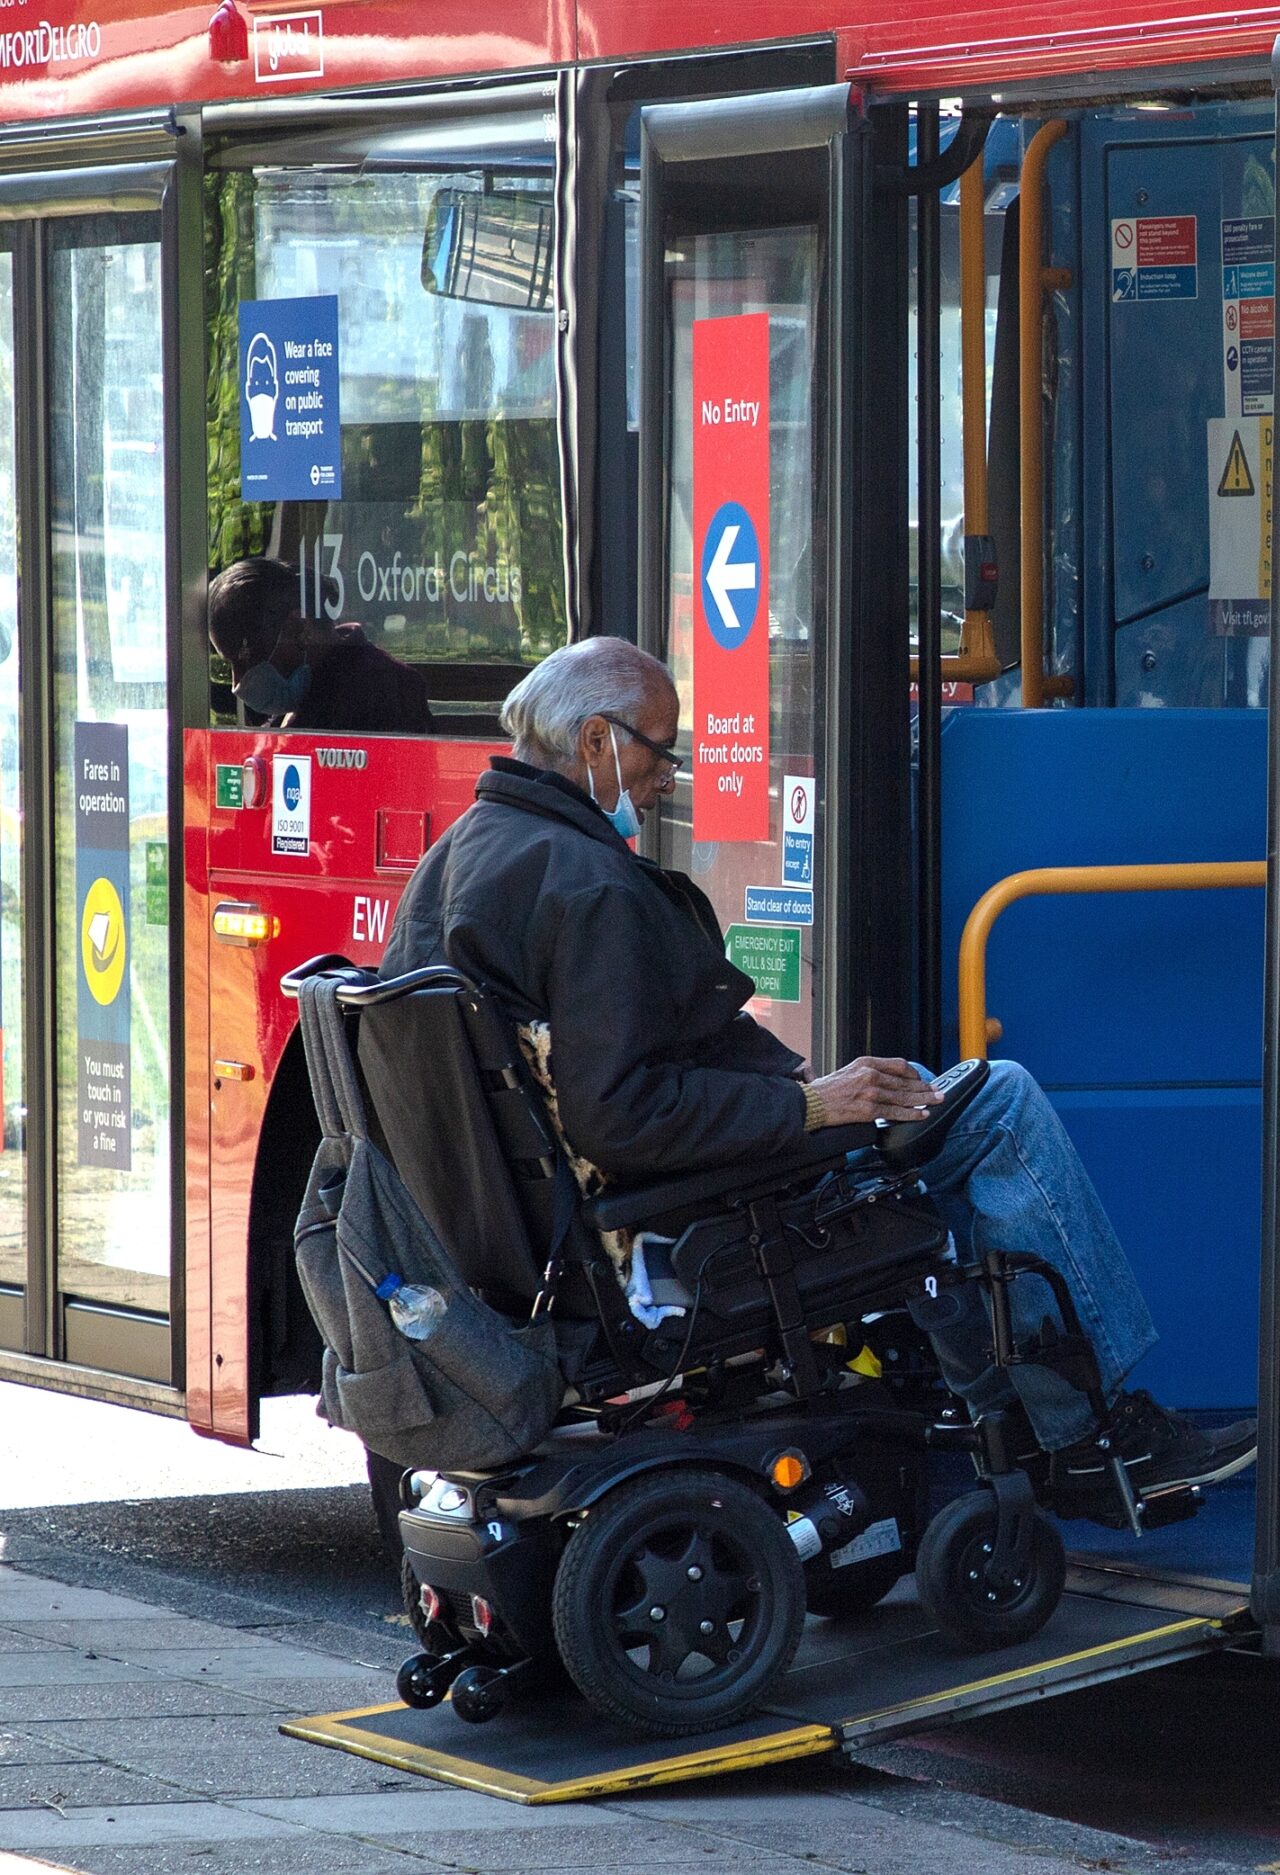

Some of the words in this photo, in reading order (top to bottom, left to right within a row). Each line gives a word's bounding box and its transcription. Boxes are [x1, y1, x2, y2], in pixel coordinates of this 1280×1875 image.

[284, 341, 306, 358] Wear
[307, 345, 312, 357] a
[314, 339, 332, 357] face
[285, 366, 320, 387] covering
[285, 396, 297, 411] on
[298, 391, 323, 413] public
[702, 400, 720, 425] No
[724, 398, 760, 427] Entry
[285, 418, 323, 439] transport
[299, 533, 345, 621] 113
[358, 550, 439, 602] Oxford
[450, 550, 522, 603] Circus
[1243, 610, 1269, 628] tfl.gov
[707, 712, 740, 734] Board
[743, 714, 755, 734] at
[315, 747, 367, 769] VOLVO
[699, 742, 728, 763] front
[730, 741, 763, 763] doors
[83, 758, 109, 781] Fares
[110, 760, 120, 781] in
[718, 770, 743, 797] only
[80, 791, 125, 816] operation
[277, 820, 289, 832] ISO
[290, 820, 304, 833] 9001
[276, 837, 305, 852] Registered
[785, 835, 795, 848] No
[796, 837, 811, 852] entry
[747, 897, 766, 913] Stand
[767, 899, 782, 913] clear
[783, 900, 791, 913] of
[792, 900, 811, 915] doors
[353, 896, 389, 944] EW
[735, 935, 778, 952] EMERGENCY
[779, 938, 795, 953] EXIT
[742, 956, 760, 970] PULL
[761, 957, 766, 970] &
[767, 957, 787, 972] SLIDE
[760, 977, 780, 991] OPEN
[84, 1056, 101, 1076] You
[102, 1062, 124, 1079] must
[87, 1083, 112, 1102] touch
[113, 1086, 121, 1103] in
[83, 1109, 92, 1124] or
[94, 1111, 109, 1129] you
[111, 1110, 126, 1128] risk
[93, 1134, 98, 1149] a
[100, 1132, 116, 1152] fine
